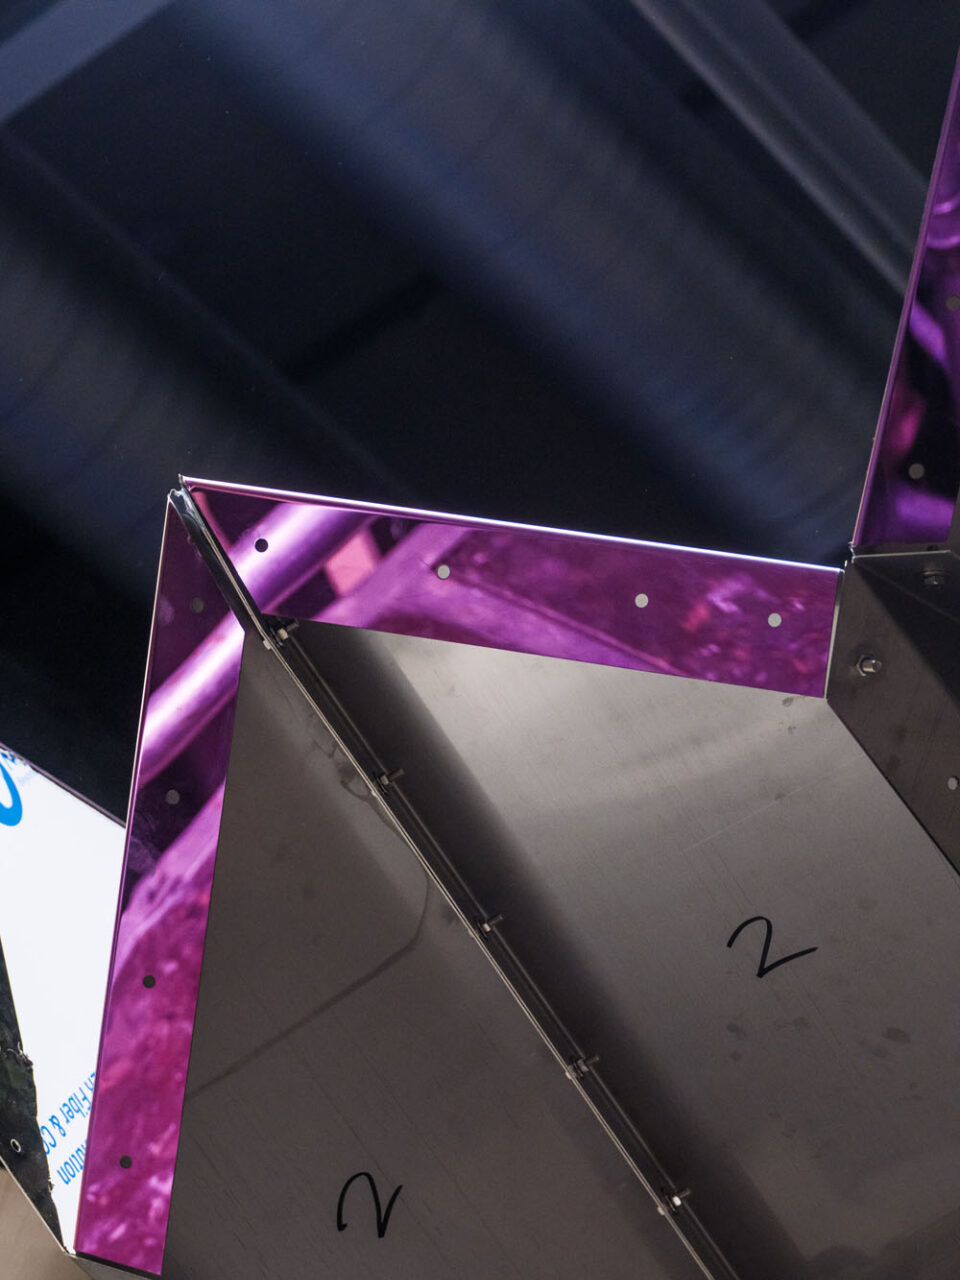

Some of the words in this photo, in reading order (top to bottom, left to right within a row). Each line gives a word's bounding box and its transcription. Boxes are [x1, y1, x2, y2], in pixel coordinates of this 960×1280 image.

[726, 915, 818, 979] 2
[48, 1115, 66, 1137] &
[58, 1086, 92, 1124] Fiber
[336, 1171, 403, 1239] 2
